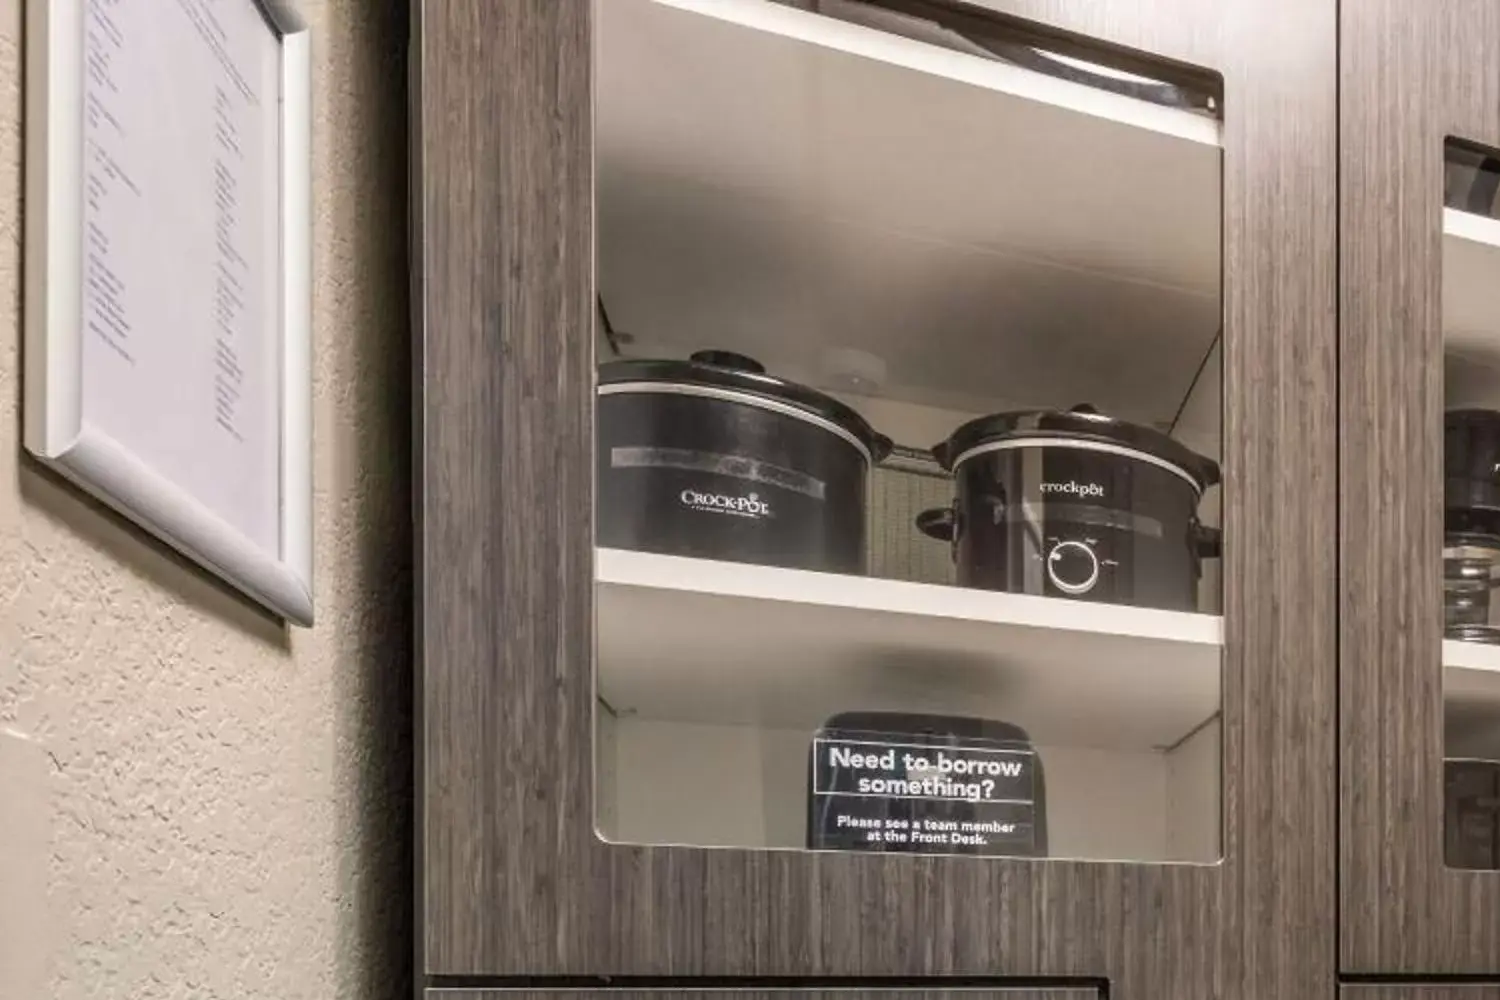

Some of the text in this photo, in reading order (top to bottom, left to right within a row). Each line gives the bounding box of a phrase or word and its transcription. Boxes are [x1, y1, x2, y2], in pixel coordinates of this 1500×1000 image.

[829, 747, 1023, 777] Need to borrow
[858, 776, 996, 803] something?
[836, 815, 1016, 833] Please see a team member
[866, 831, 988, 846] at the Front Desk.
